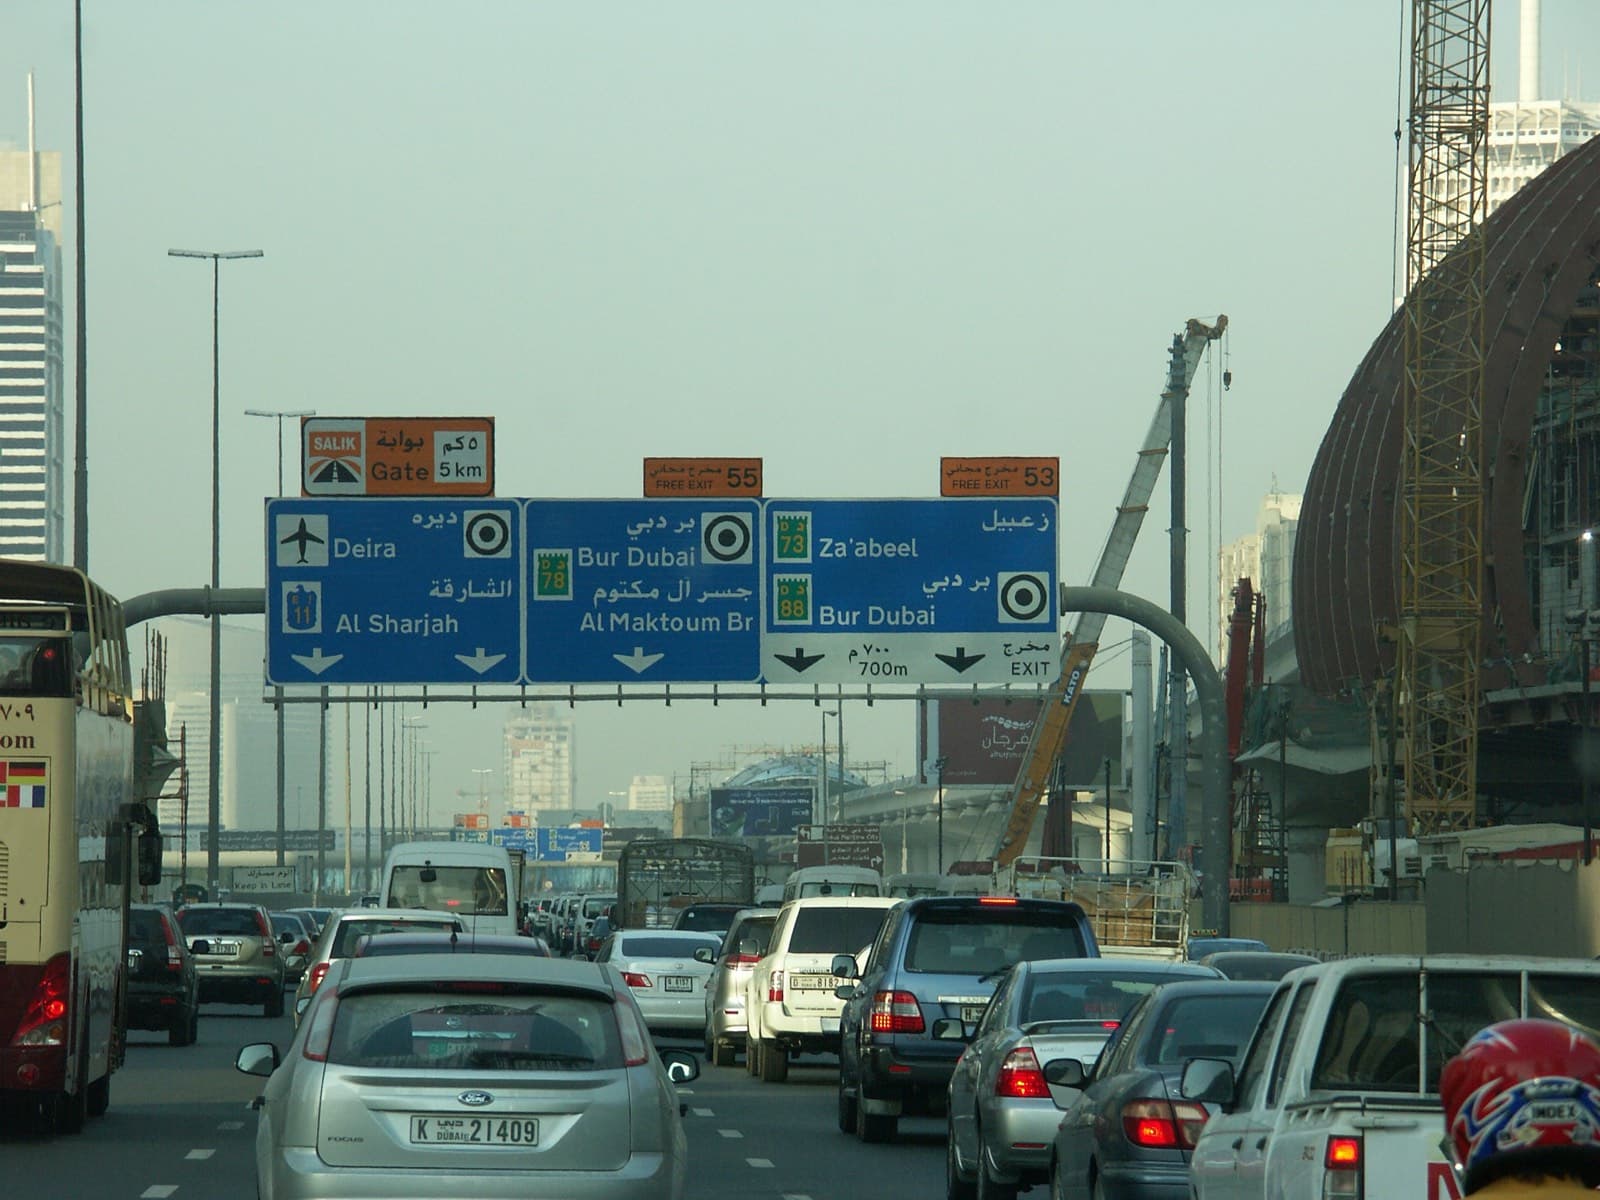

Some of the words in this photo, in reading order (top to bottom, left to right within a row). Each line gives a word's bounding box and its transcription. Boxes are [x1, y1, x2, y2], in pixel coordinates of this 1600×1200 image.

[314, 436, 356, 451] SALIK
[376, 430, 424, 453] بوابة
[443, 436, 464, 455] كم
[371, 462, 430, 481] Gate
[439, 462, 451, 478] 5
[455, 462, 482, 478] km
[727, 467, 758, 489] 55
[1024, 466, 1055, 487] 53
[656, 480, 685, 489] FREE
[688, 480, 713, 489] EXIT
[952, 480, 980, 489] FREE
[985, 480, 1009, 489] EXIT
[626, 514, 668, 541] دبي
[674, 515, 696, 534] بر
[982, 509, 1049, 532] زعبيل
[333, 538, 396, 558] Deira
[780, 535, 804, 554] 73
[819, 537, 919, 558] Za'abeel
[578, 548, 620, 567] Bur
[627, 547, 696, 567] Dubai
[429, 578, 512, 603] الشارقة
[542, 572, 565, 589] 78
[922, 573, 963, 598] دبي
[968, 576, 991, 591] بر
[593, 580, 660, 609] مكتوم
[697, 586, 753, 603] جسر
[295, 607, 311, 625] 11
[781, 600, 804, 617] 88
[819, 606, 860, 625] Bur
[868, 605, 936, 625] Dubai
[336, 614, 361, 634] Al
[369, 613, 459, 637] Sharjah
[580, 612, 604, 632] Al
[610, 612, 721, 632] Maktoum
[728, 612, 753, 631] Br
[1003, 641, 1050, 656] مخرج
[859, 661, 908, 676] 700m
[1011, 661, 1051, 676] EXIT
[1063, 670, 1080, 703] KATO
[417, 1119, 429, 1140] K
[470, 1119, 535, 1142] 21409
